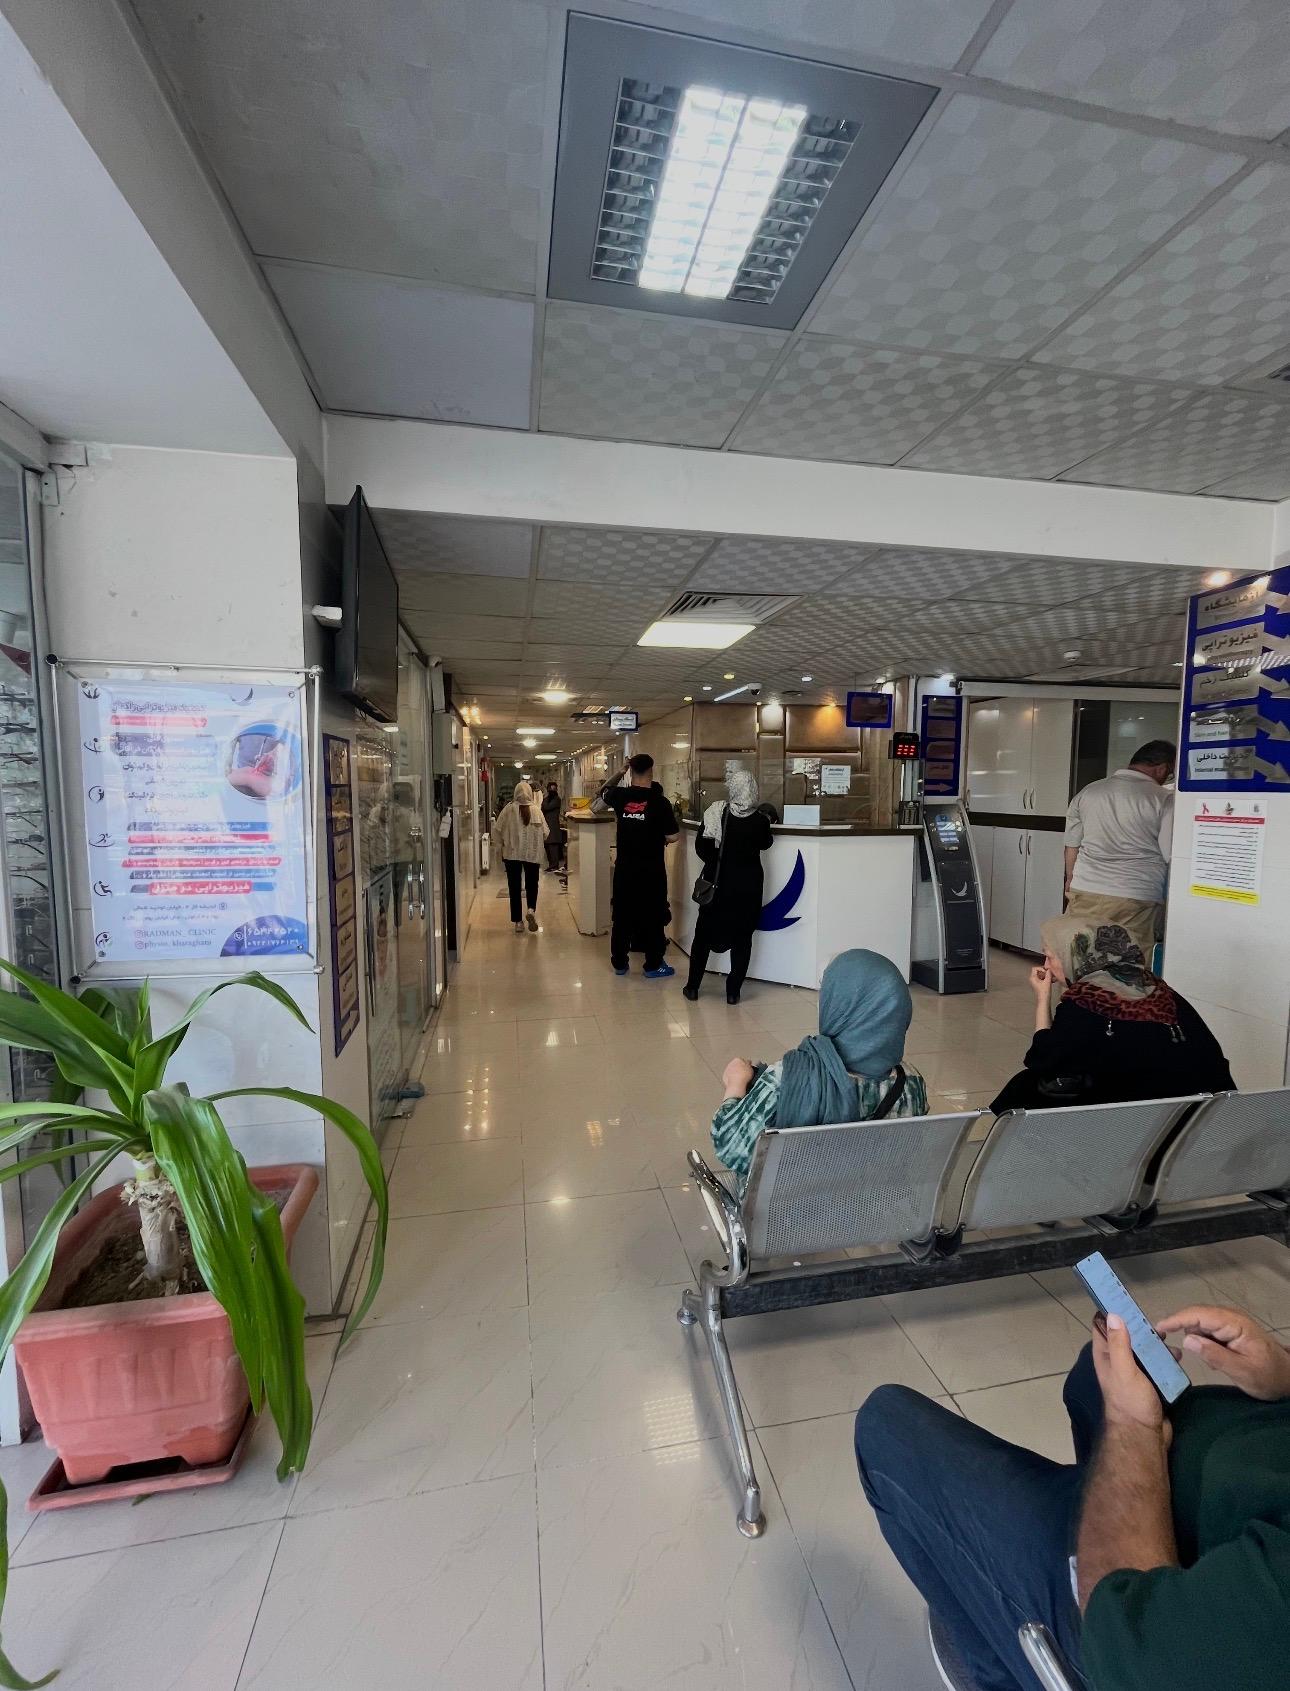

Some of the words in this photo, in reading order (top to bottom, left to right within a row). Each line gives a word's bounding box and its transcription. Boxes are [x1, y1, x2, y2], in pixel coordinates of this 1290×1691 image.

[1201, 628, 1259, 653] فیزیوتراپی
[1196, 752, 1218, 763] داخلی
[151, 882, 178, 896] منزل
[195, 881, 251, 894] فیزیوتراپی
